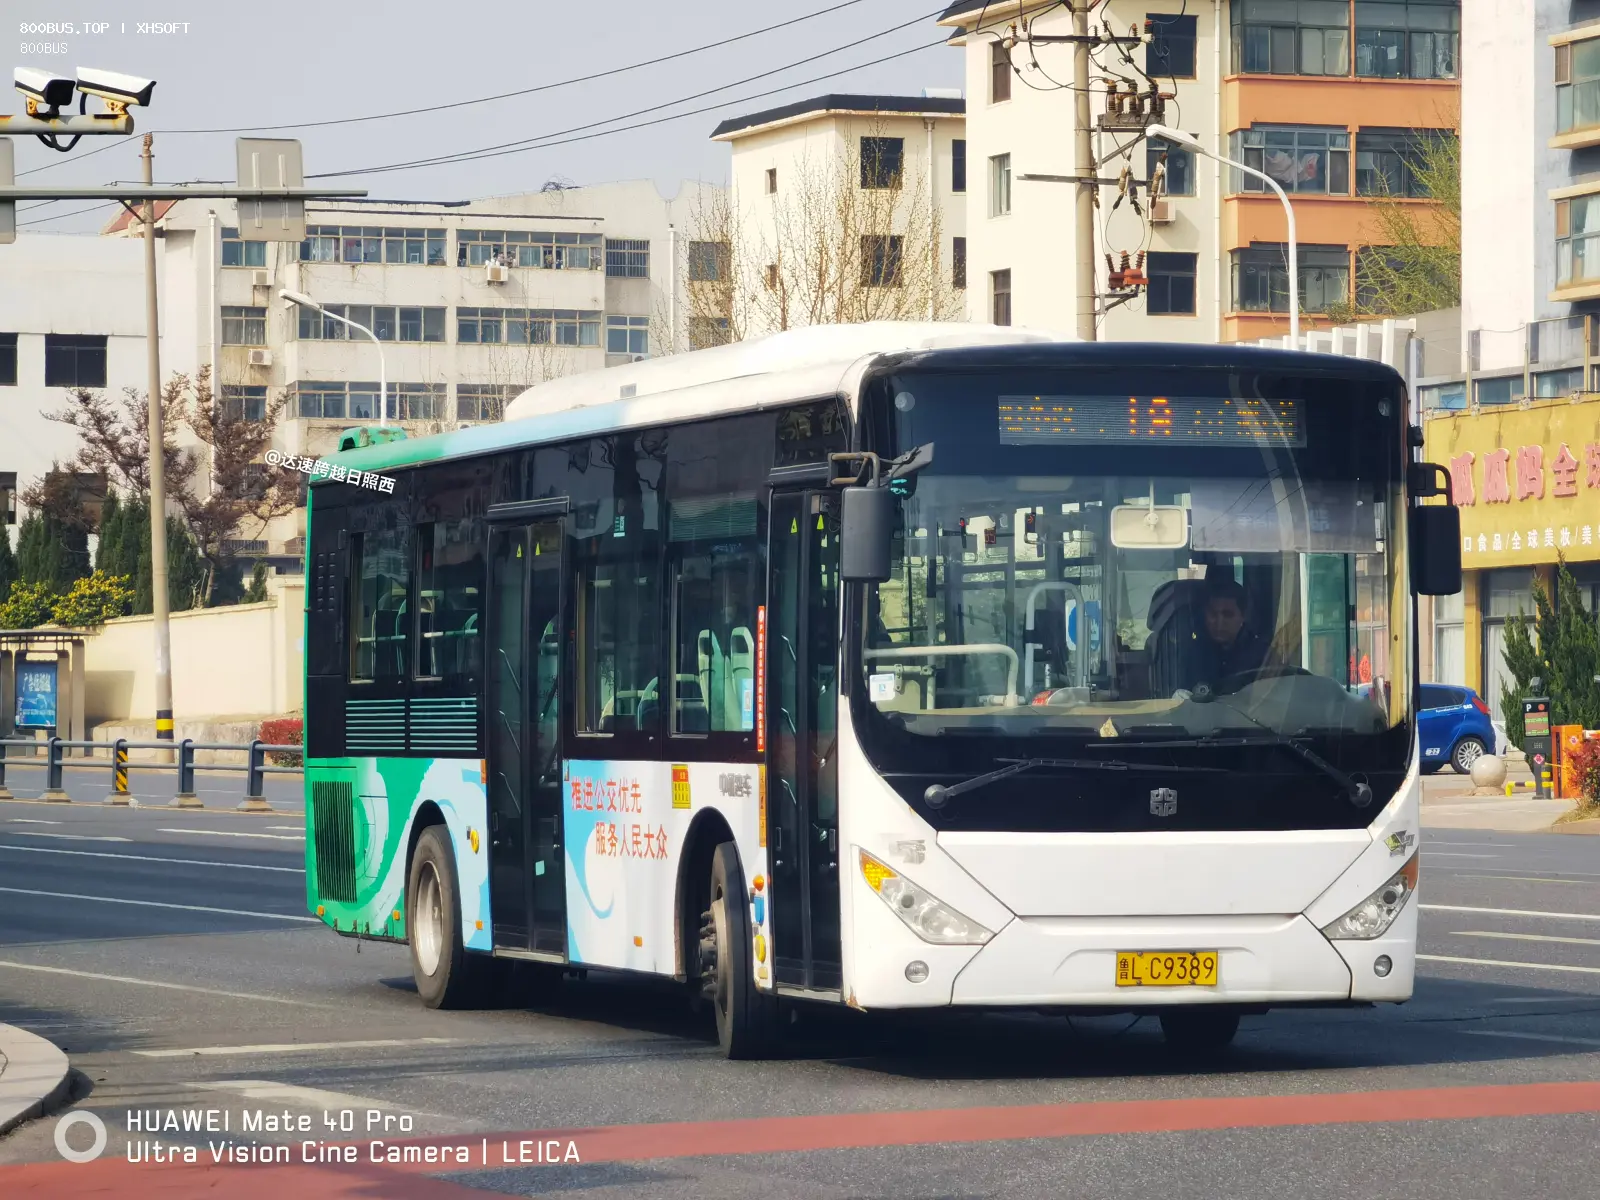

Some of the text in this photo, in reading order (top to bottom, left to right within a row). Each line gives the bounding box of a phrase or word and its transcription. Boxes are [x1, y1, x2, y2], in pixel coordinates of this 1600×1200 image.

[571, 776, 642, 814] 推进公交优先
[595, 820, 668, 860] 服务人民大众
